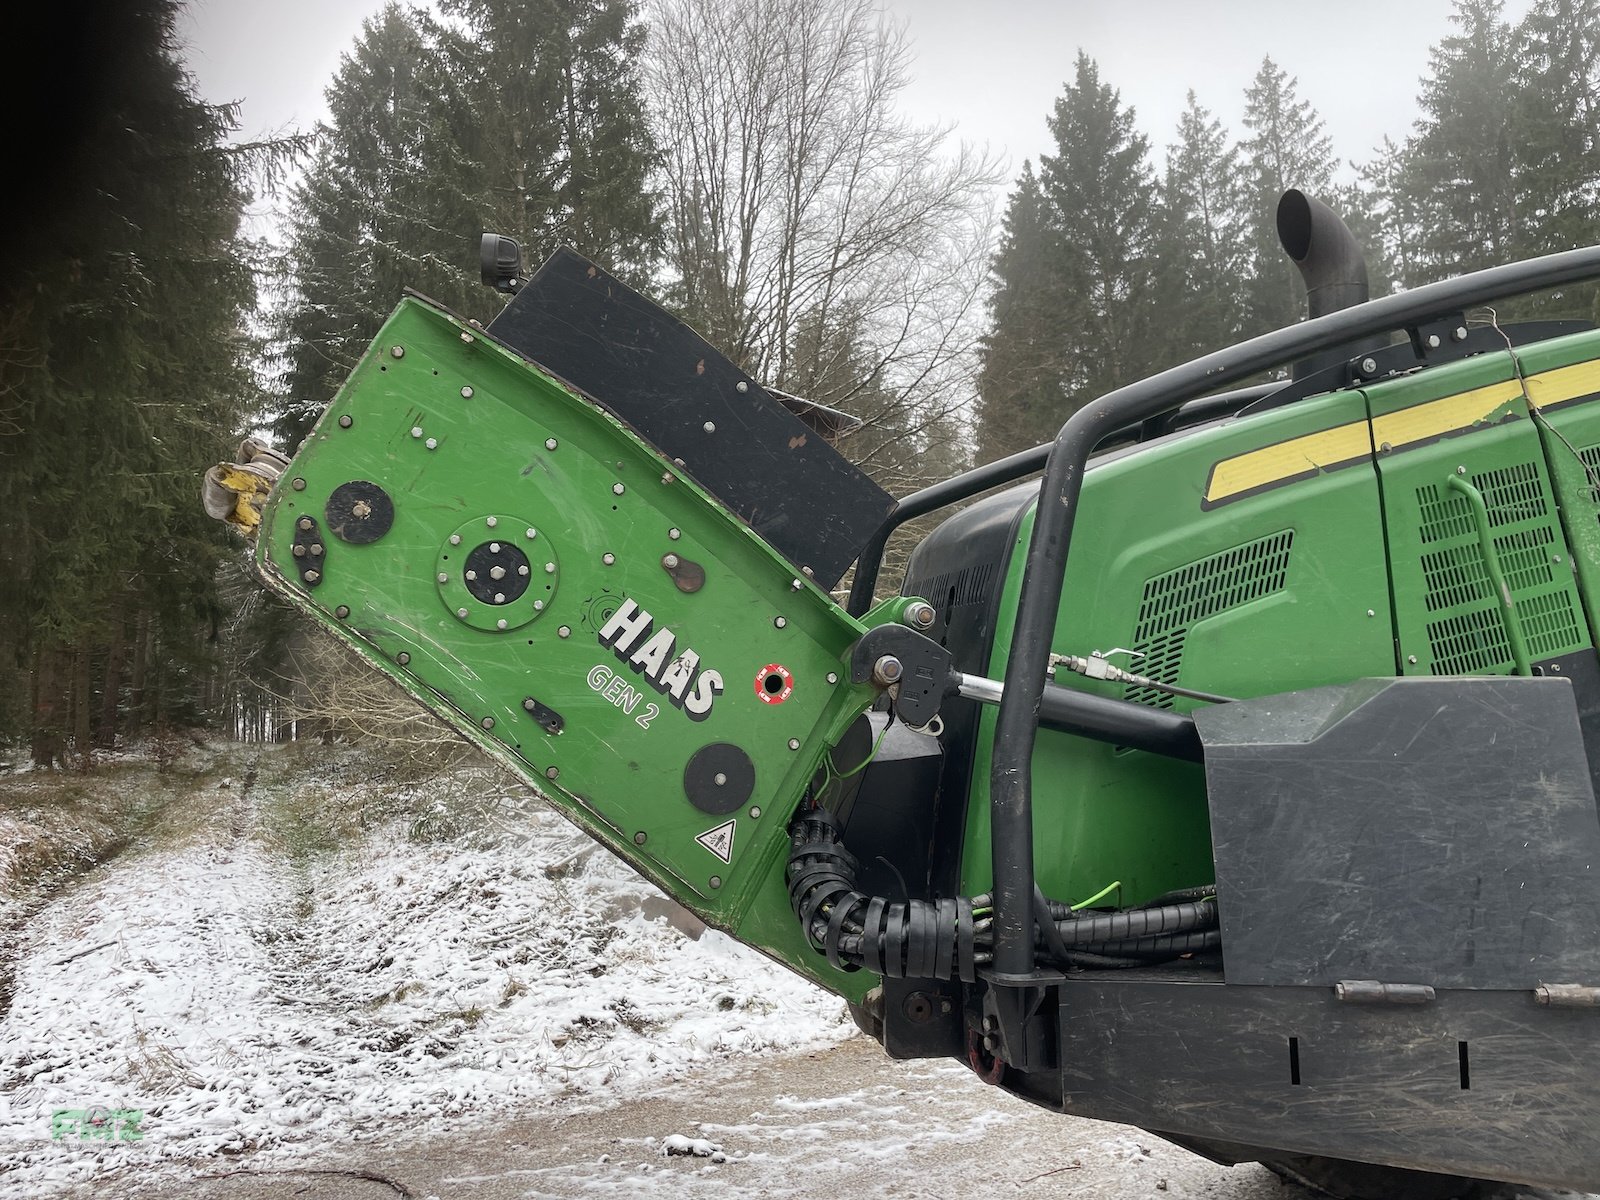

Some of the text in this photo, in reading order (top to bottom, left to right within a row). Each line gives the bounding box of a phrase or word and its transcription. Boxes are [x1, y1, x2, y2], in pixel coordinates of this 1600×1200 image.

[587, 665, 660, 729] GEN 2
[598, 598, 724, 722] HAAS
